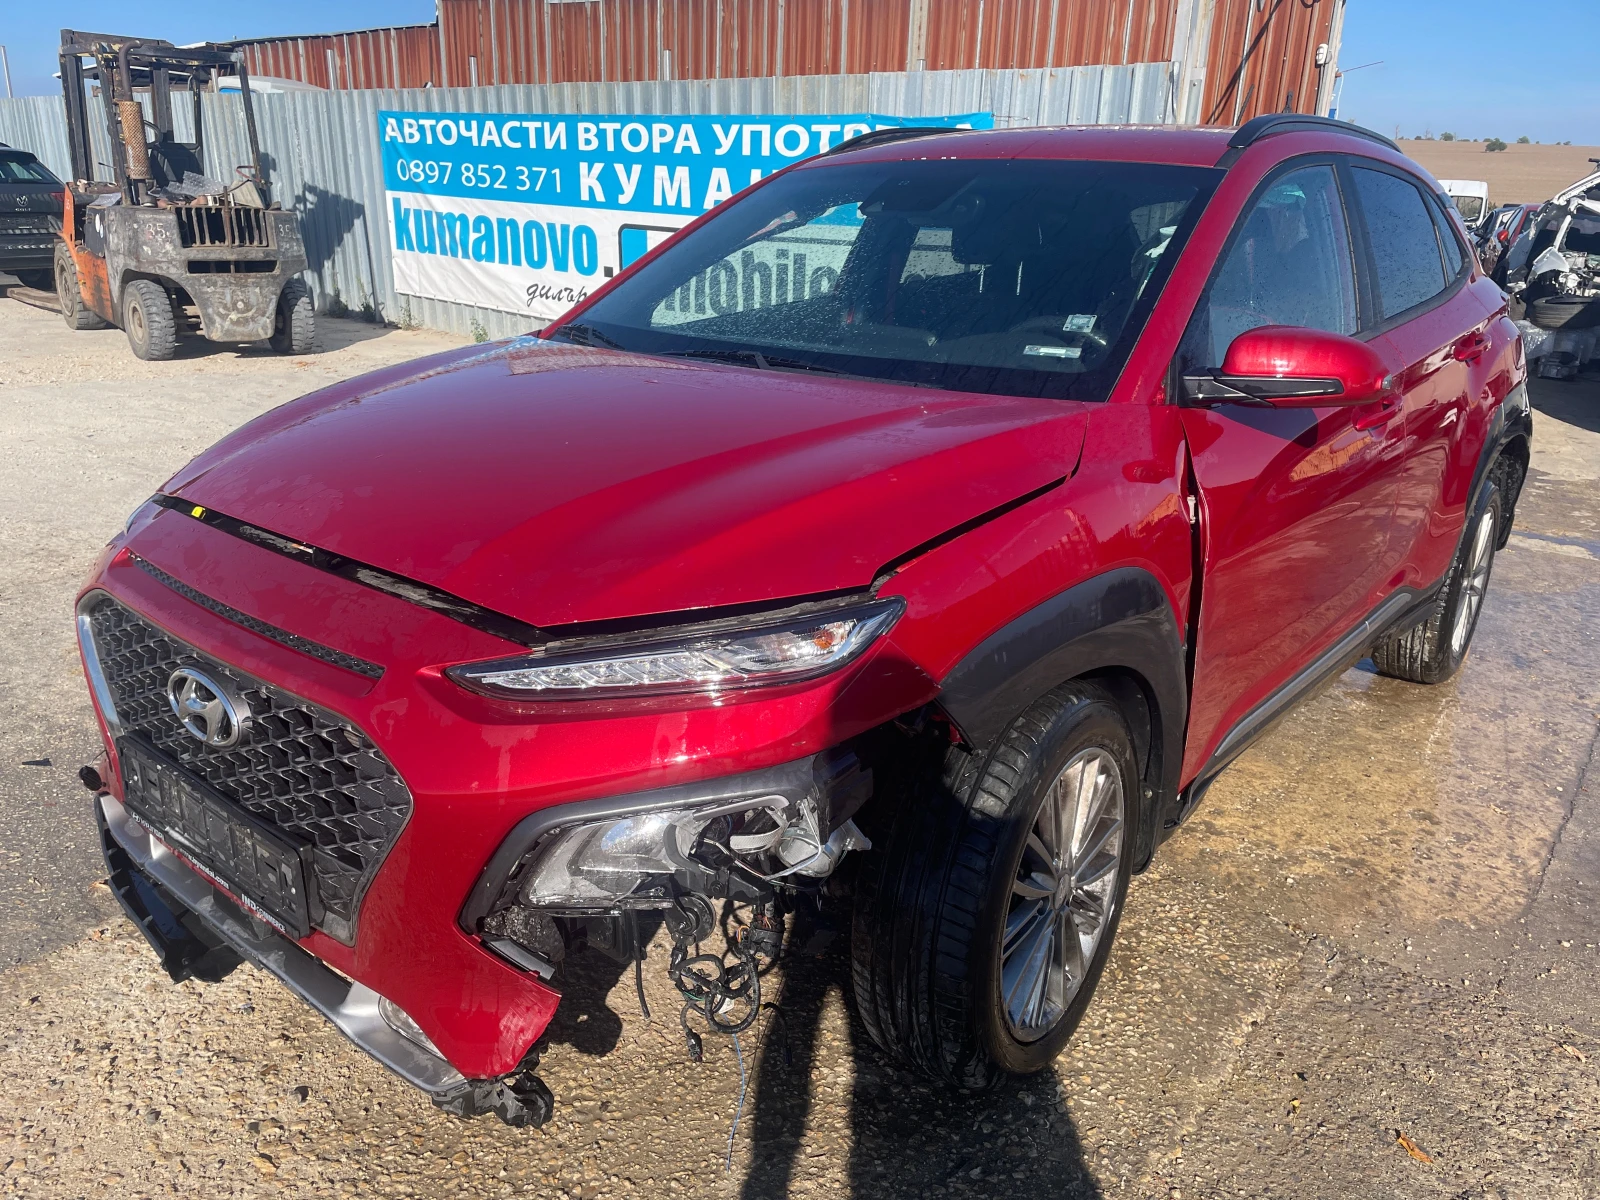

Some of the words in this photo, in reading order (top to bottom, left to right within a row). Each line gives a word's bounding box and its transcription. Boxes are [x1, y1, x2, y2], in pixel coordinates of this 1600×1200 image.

[384, 117, 567, 150] АВТОЧАСТИ
[577, 122, 702, 155] ВТОРА
[714, 123, 973, 157] УПОТР
[396, 159, 453, 185] 0897
[461, 163, 508, 190] 852
[515, 165, 561, 193] 371
